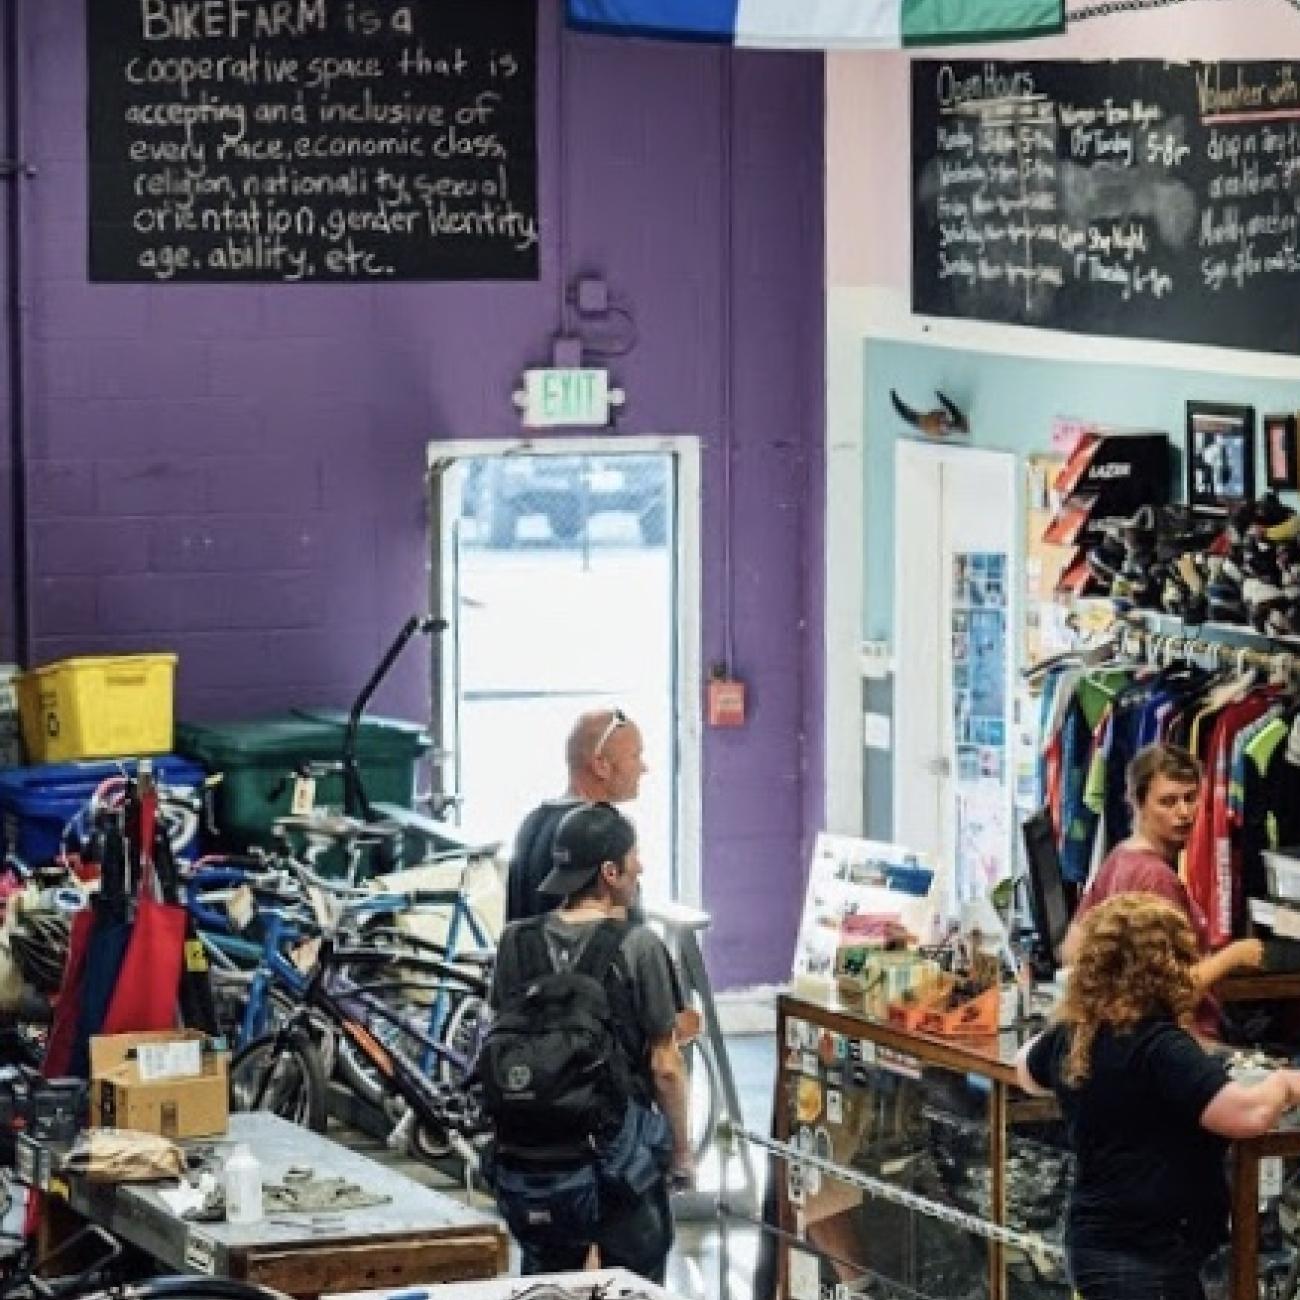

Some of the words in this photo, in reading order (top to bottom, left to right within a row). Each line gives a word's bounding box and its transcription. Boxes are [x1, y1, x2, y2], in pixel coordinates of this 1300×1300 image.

[346, 4, 382, 37] is
[391, 8, 415, 35] a
[125, 43, 299, 99] cooperative
[302, 57, 384, 88] space
[399, 47, 468, 76] that
[489, 49, 519, 77] is
[125, 90, 248, 145] accepting
[255, 90, 307, 124] and
[320, 87, 444, 124] inclusive
[455, 90, 502, 124] of
[129, 138, 207, 176] every
[294, 126, 425, 158] economic
[414, 164, 508, 207] sexual
[324, 237, 396, 275] etc.
[544, 371, 597, 417] EXIT
